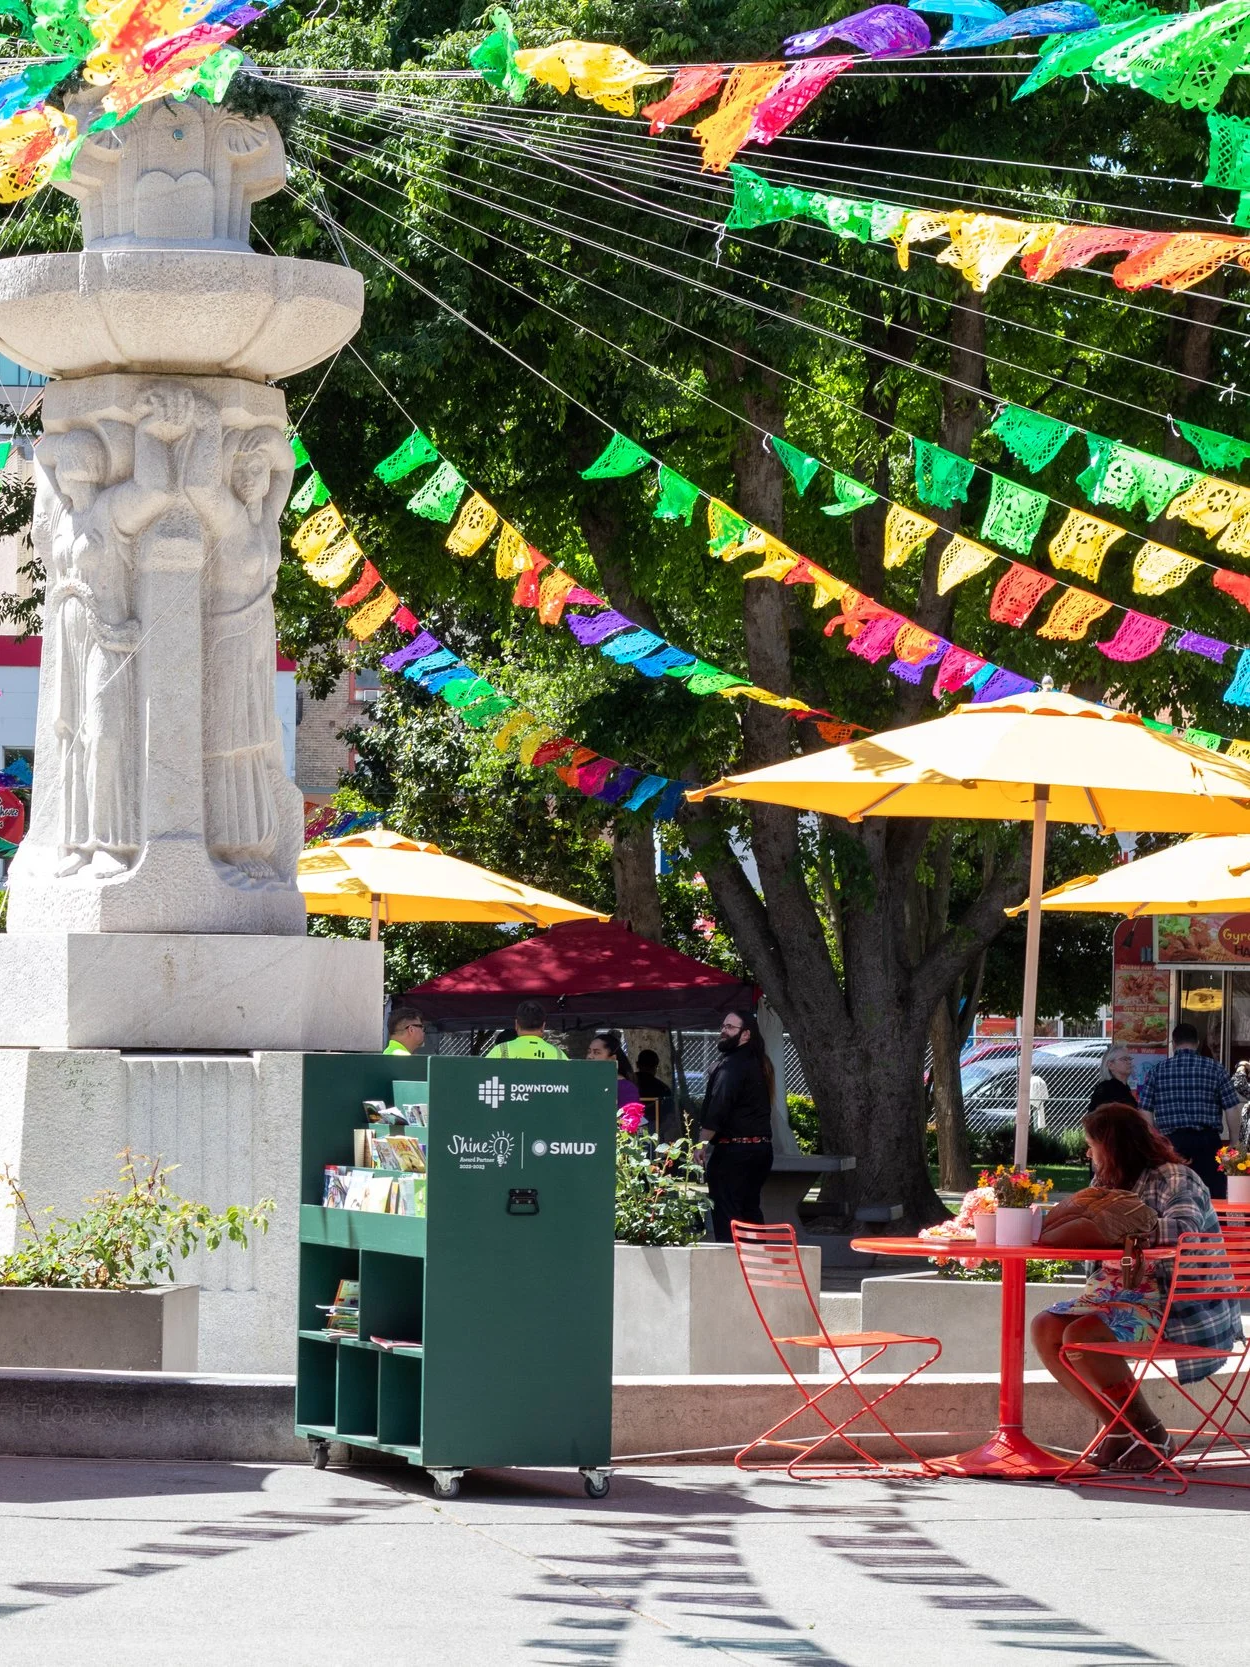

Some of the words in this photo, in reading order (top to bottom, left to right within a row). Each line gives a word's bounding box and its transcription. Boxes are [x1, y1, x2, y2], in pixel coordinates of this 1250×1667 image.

[510, 1084, 569, 1093] DOWNTOWN
[510, 1093, 529, 1102] SAC
[447, 1134, 490, 1155] Shine
[549, 1142, 597, 1155] SMUD
